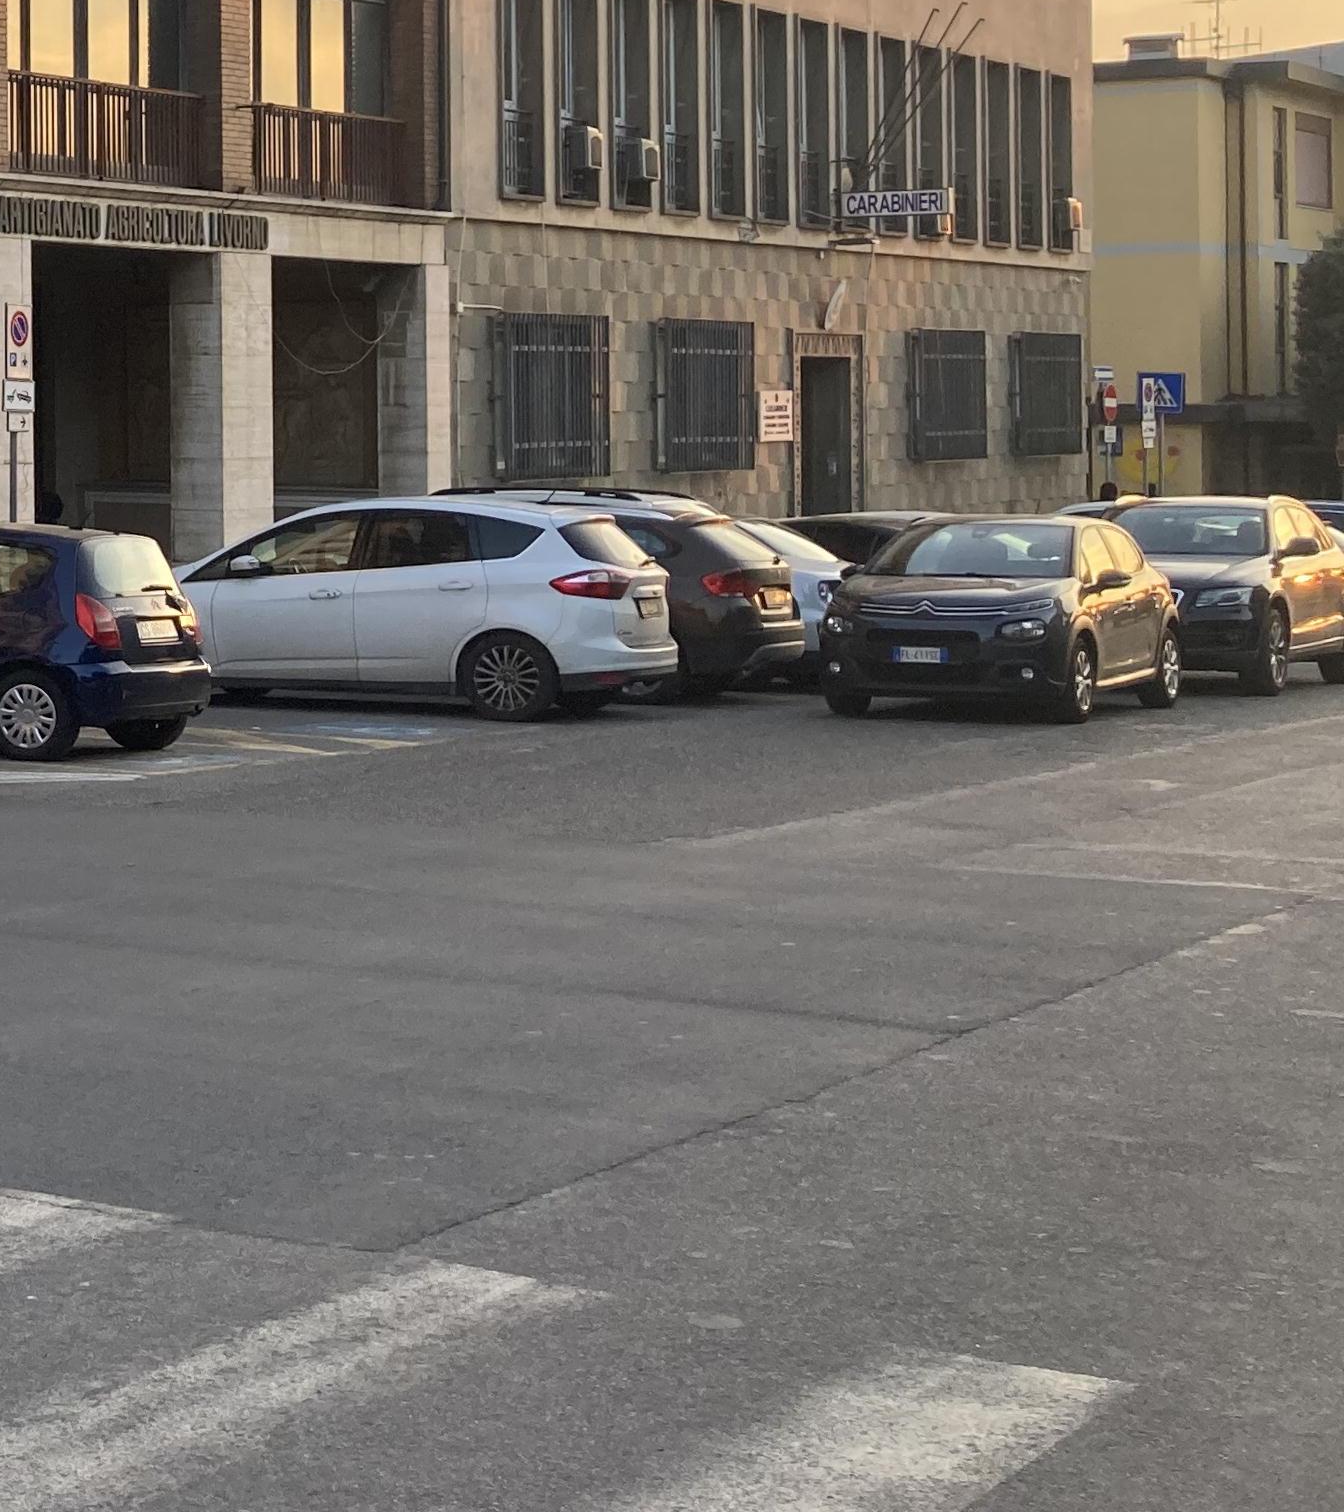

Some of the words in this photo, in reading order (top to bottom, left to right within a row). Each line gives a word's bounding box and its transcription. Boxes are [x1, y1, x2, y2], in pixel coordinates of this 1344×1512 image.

[846, 191, 943, 215] CARABINIERI
[104, 204, 206, 247] AGRICOLTURA
[207, 209, 269, 251] LIVORNO
